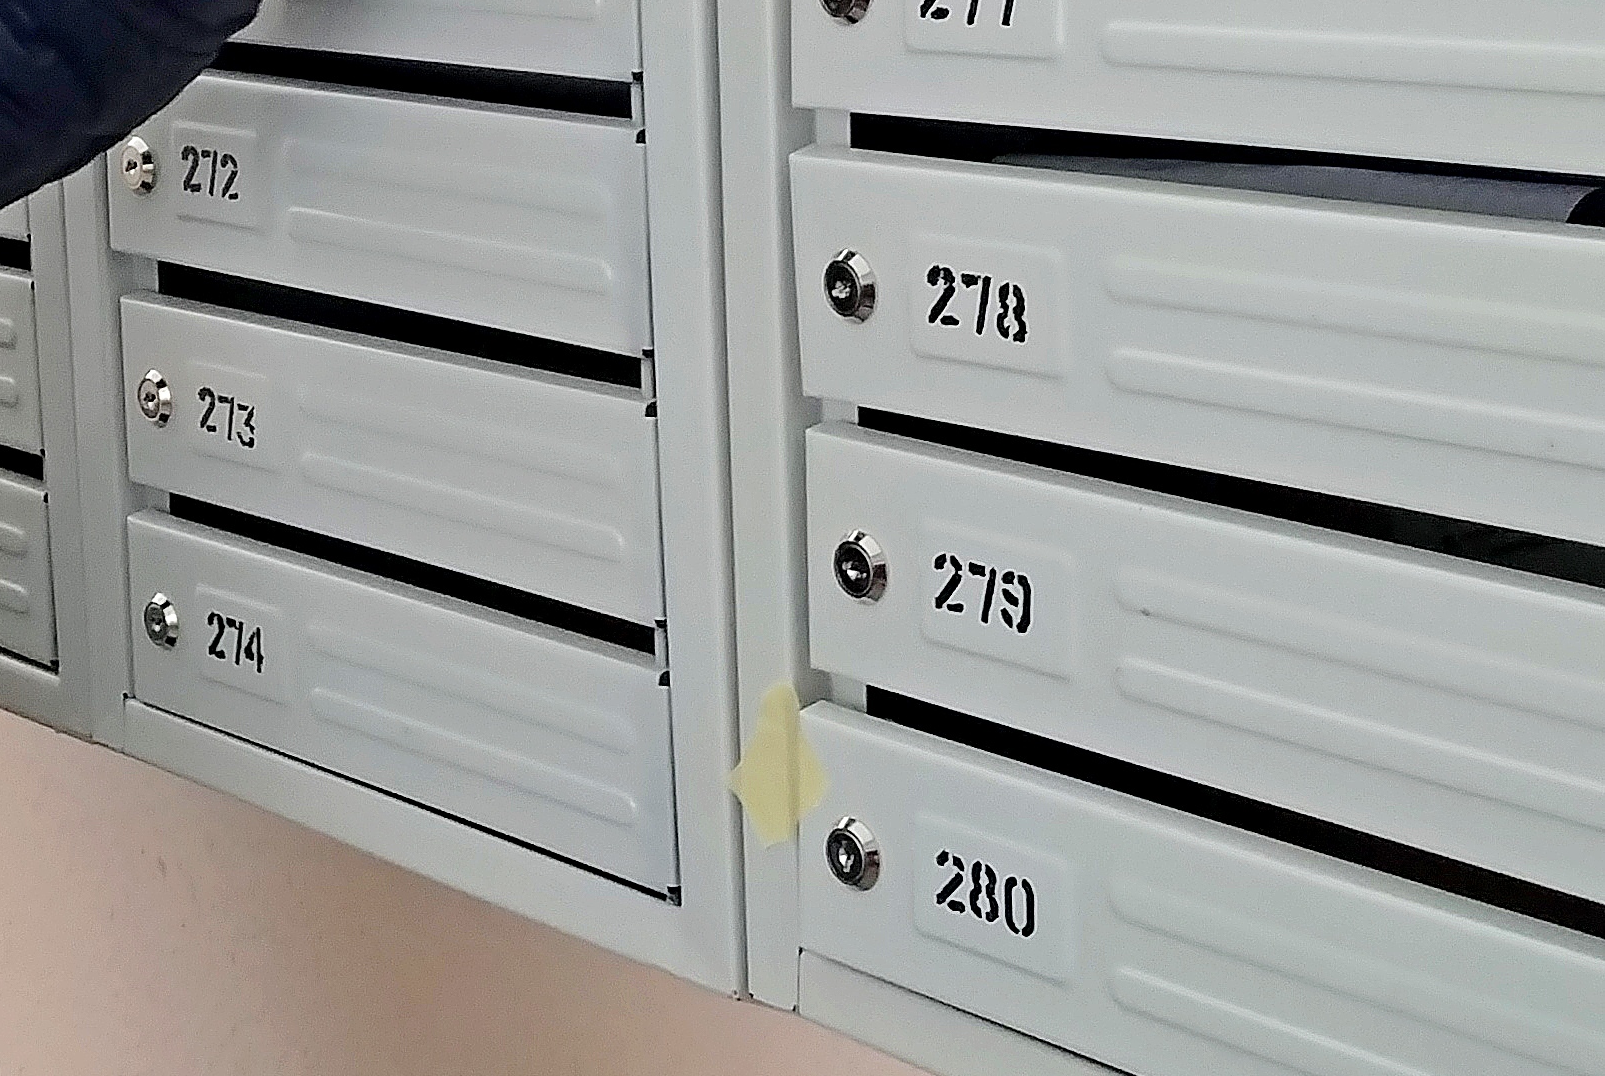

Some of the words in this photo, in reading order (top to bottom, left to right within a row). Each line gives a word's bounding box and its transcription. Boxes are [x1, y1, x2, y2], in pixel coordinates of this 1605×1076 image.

[182, 145, 240, 201] 272
[926, 265, 1028, 344] 278
[198, 387, 256, 450] 273
[933, 553, 1032, 634] 279
[207, 612, 265, 674] 274
[935, 850, 1035, 938] 280
